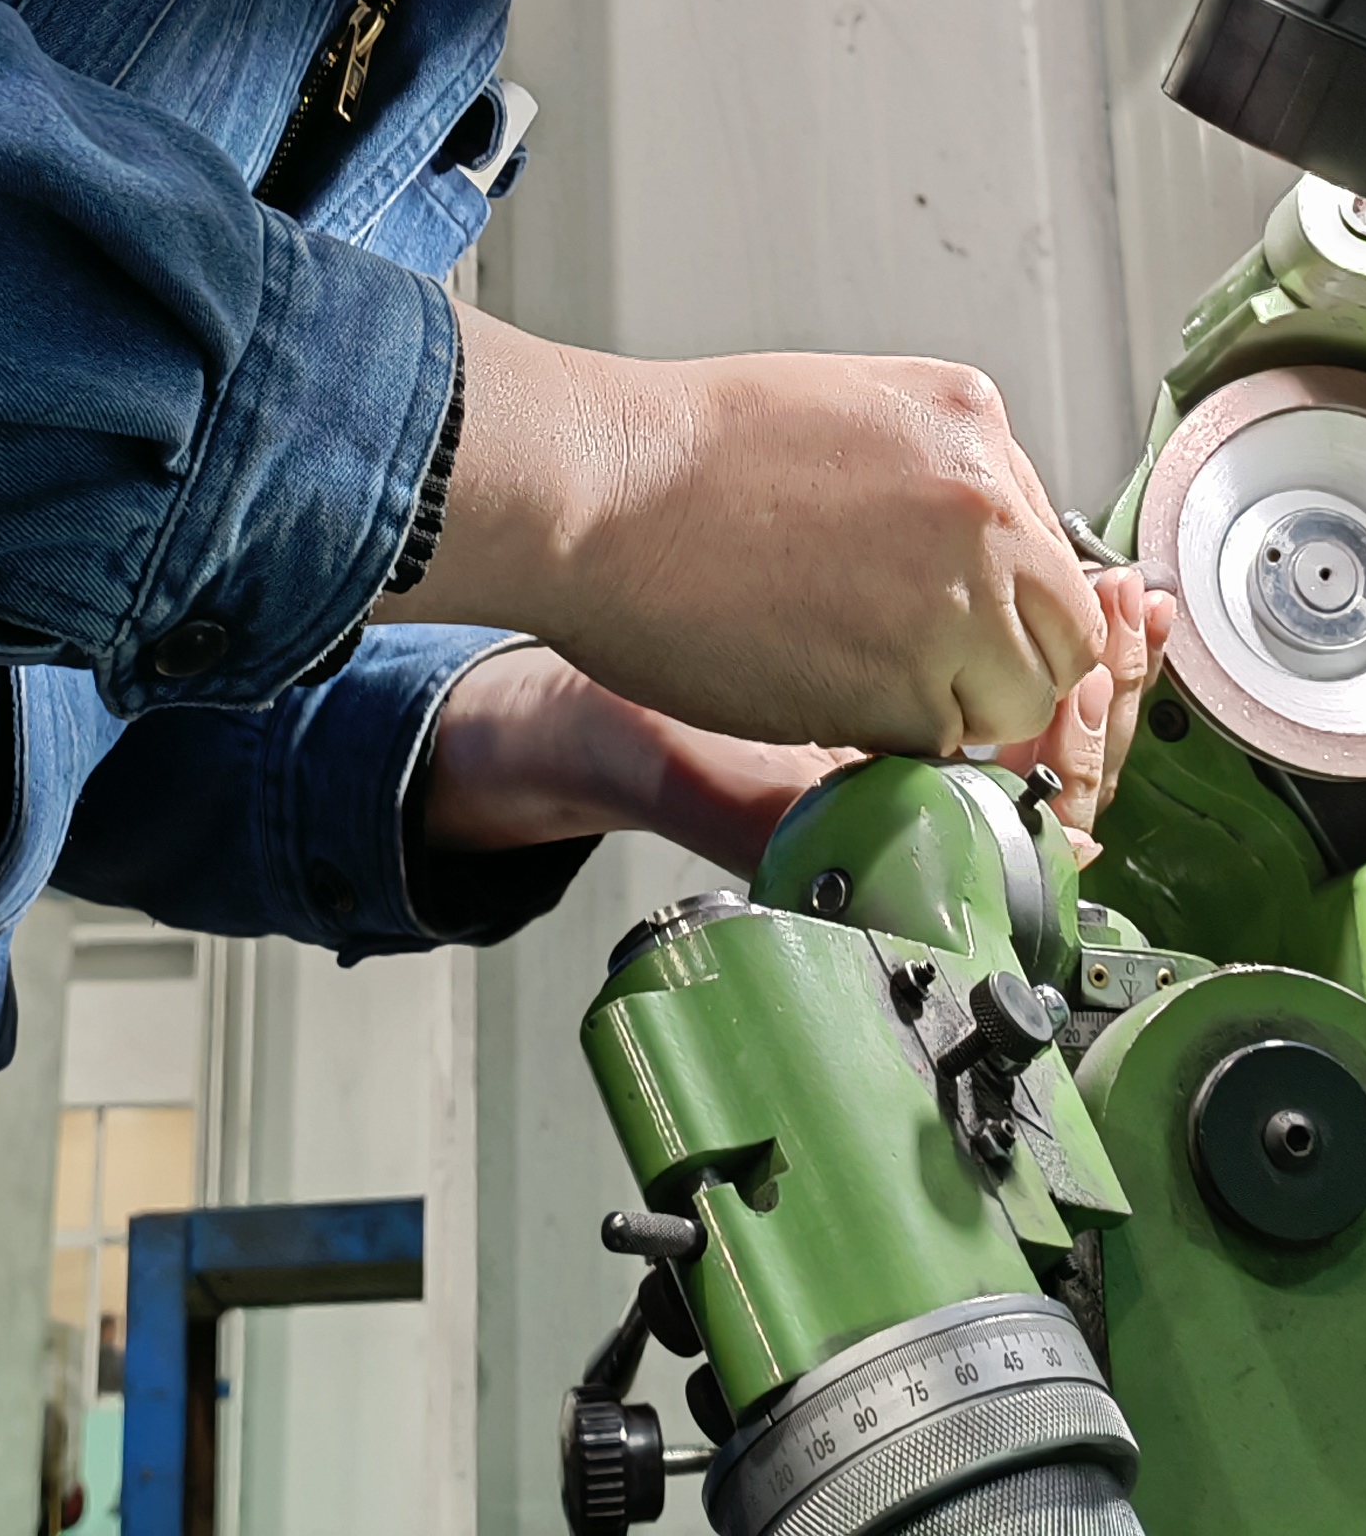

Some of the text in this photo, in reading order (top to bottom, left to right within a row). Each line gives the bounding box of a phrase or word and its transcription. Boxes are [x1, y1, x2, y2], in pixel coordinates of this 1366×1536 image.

[1064, 1029, 1081, 1044] 20
[766, 1462, 795, 1497] 120
[804, 1435, 837, 1468] 105
[852, 1406, 879, 1434] 90
[902, 1384, 930, 1408] 75
[954, 1362, 980, 1386] 60
[1002, 1350, 1025, 1372] 45
[1041, 1346, 1063, 1368] 30
